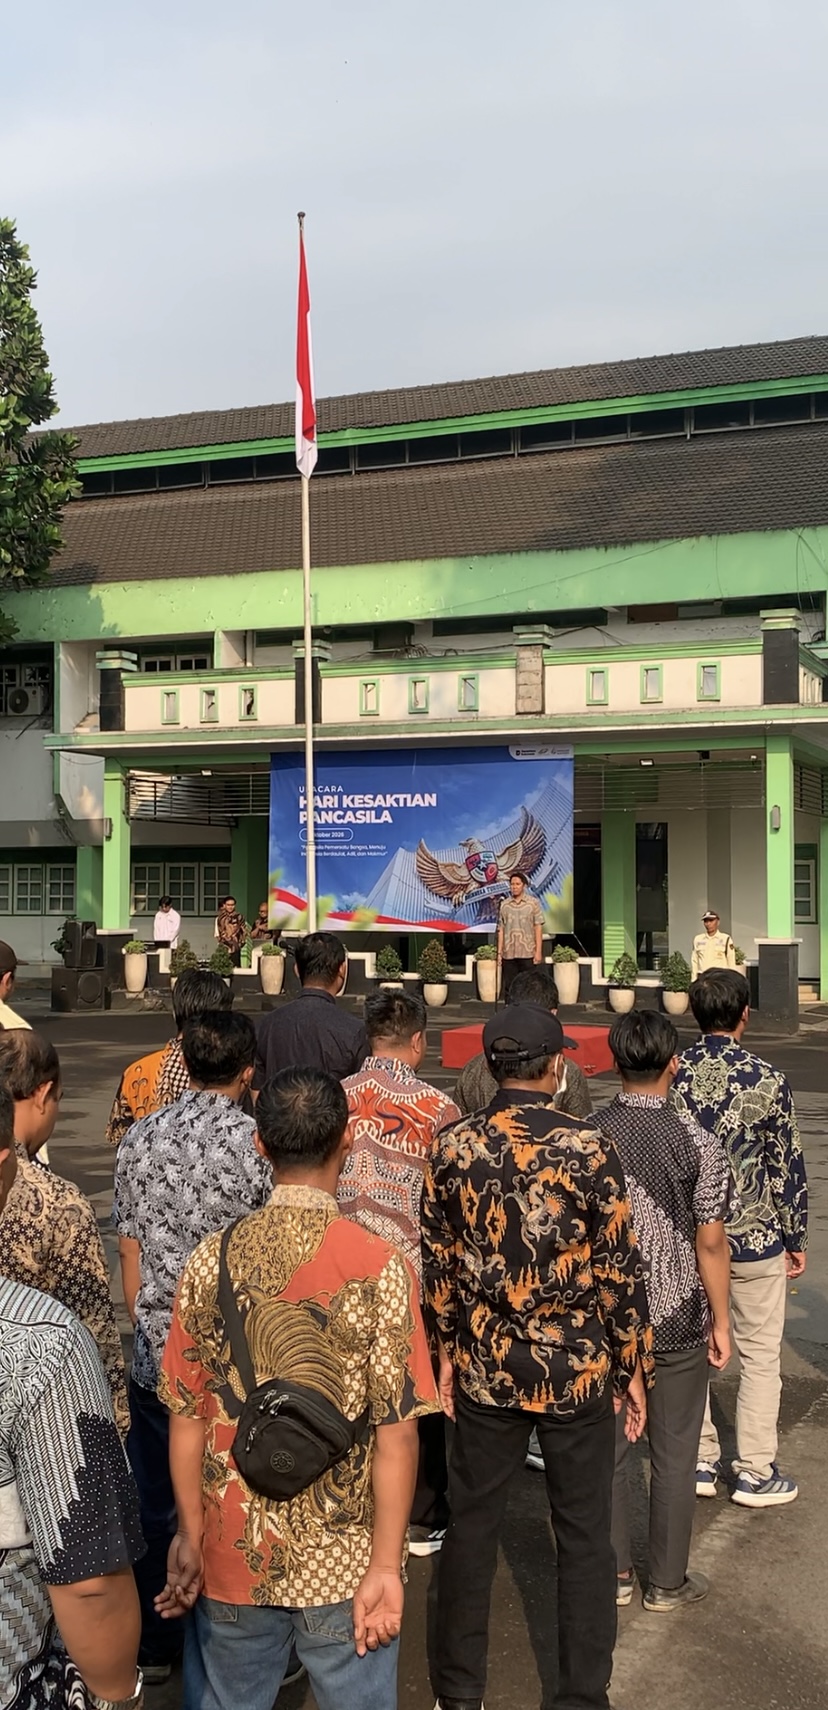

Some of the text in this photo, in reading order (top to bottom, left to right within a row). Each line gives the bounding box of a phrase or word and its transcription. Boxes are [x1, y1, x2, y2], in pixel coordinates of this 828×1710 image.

[298, 785, 344, 794] UACARA
[299, 793, 437, 809] HARI KESAKTIAN
[299, 810, 393, 825] PANCASILA
